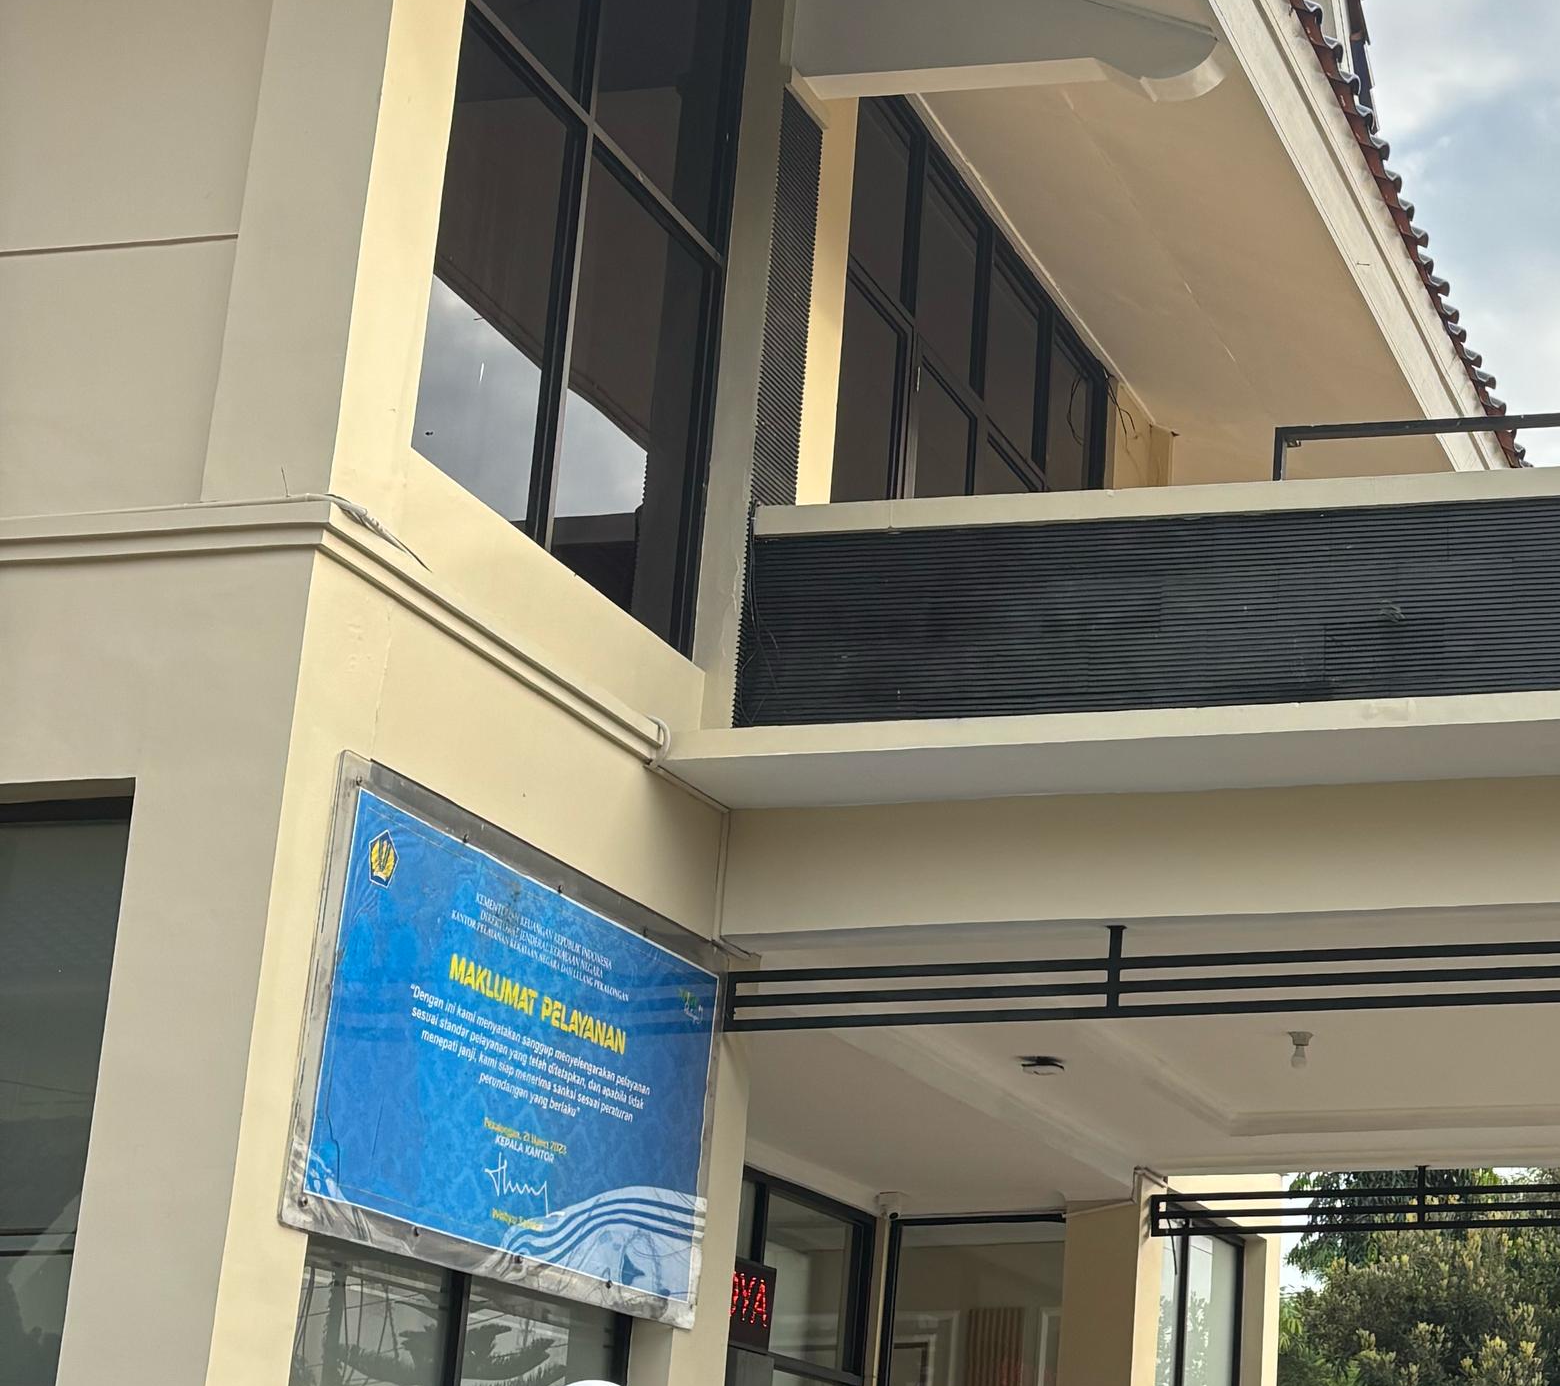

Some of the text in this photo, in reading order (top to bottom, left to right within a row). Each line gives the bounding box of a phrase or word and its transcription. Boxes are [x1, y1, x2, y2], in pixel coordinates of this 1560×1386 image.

[444, 1002, 455, 1013] ini
[456, 1004, 476, 1022] kami
[476, 1016, 520, 1042] menyatakan
[521, 1036, 553, 1057] sanggup
[615, 1075, 649, 1095] pelayanan
[449, 953, 537, 1014] MAKLUMAT
[541, 996, 625, 1054] PELAYANAN
[411, 1006, 438, 1025] sesuai
[439, 1018, 469, 1037] standar
[469, 1031, 507, 1054] pelayanan
[508, 1048, 527, 1065] yang
[529, 1055, 546, 1070] telah
[587, 1079, 600, 1093] dan
[421, 1029, 458, 1052] menepati
[478, 1051, 497, 1067] kami
[498, 1061, 514, 1077] siap
[514, 1068, 551, 1090] menerima
[600, 1102, 632, 1122] peraturan
[478, 1072, 528, 1098] perundangan
[529, 1092, 548, 1109] yang
[495, 1135, 554, 1162] KEPALA KANTOR
